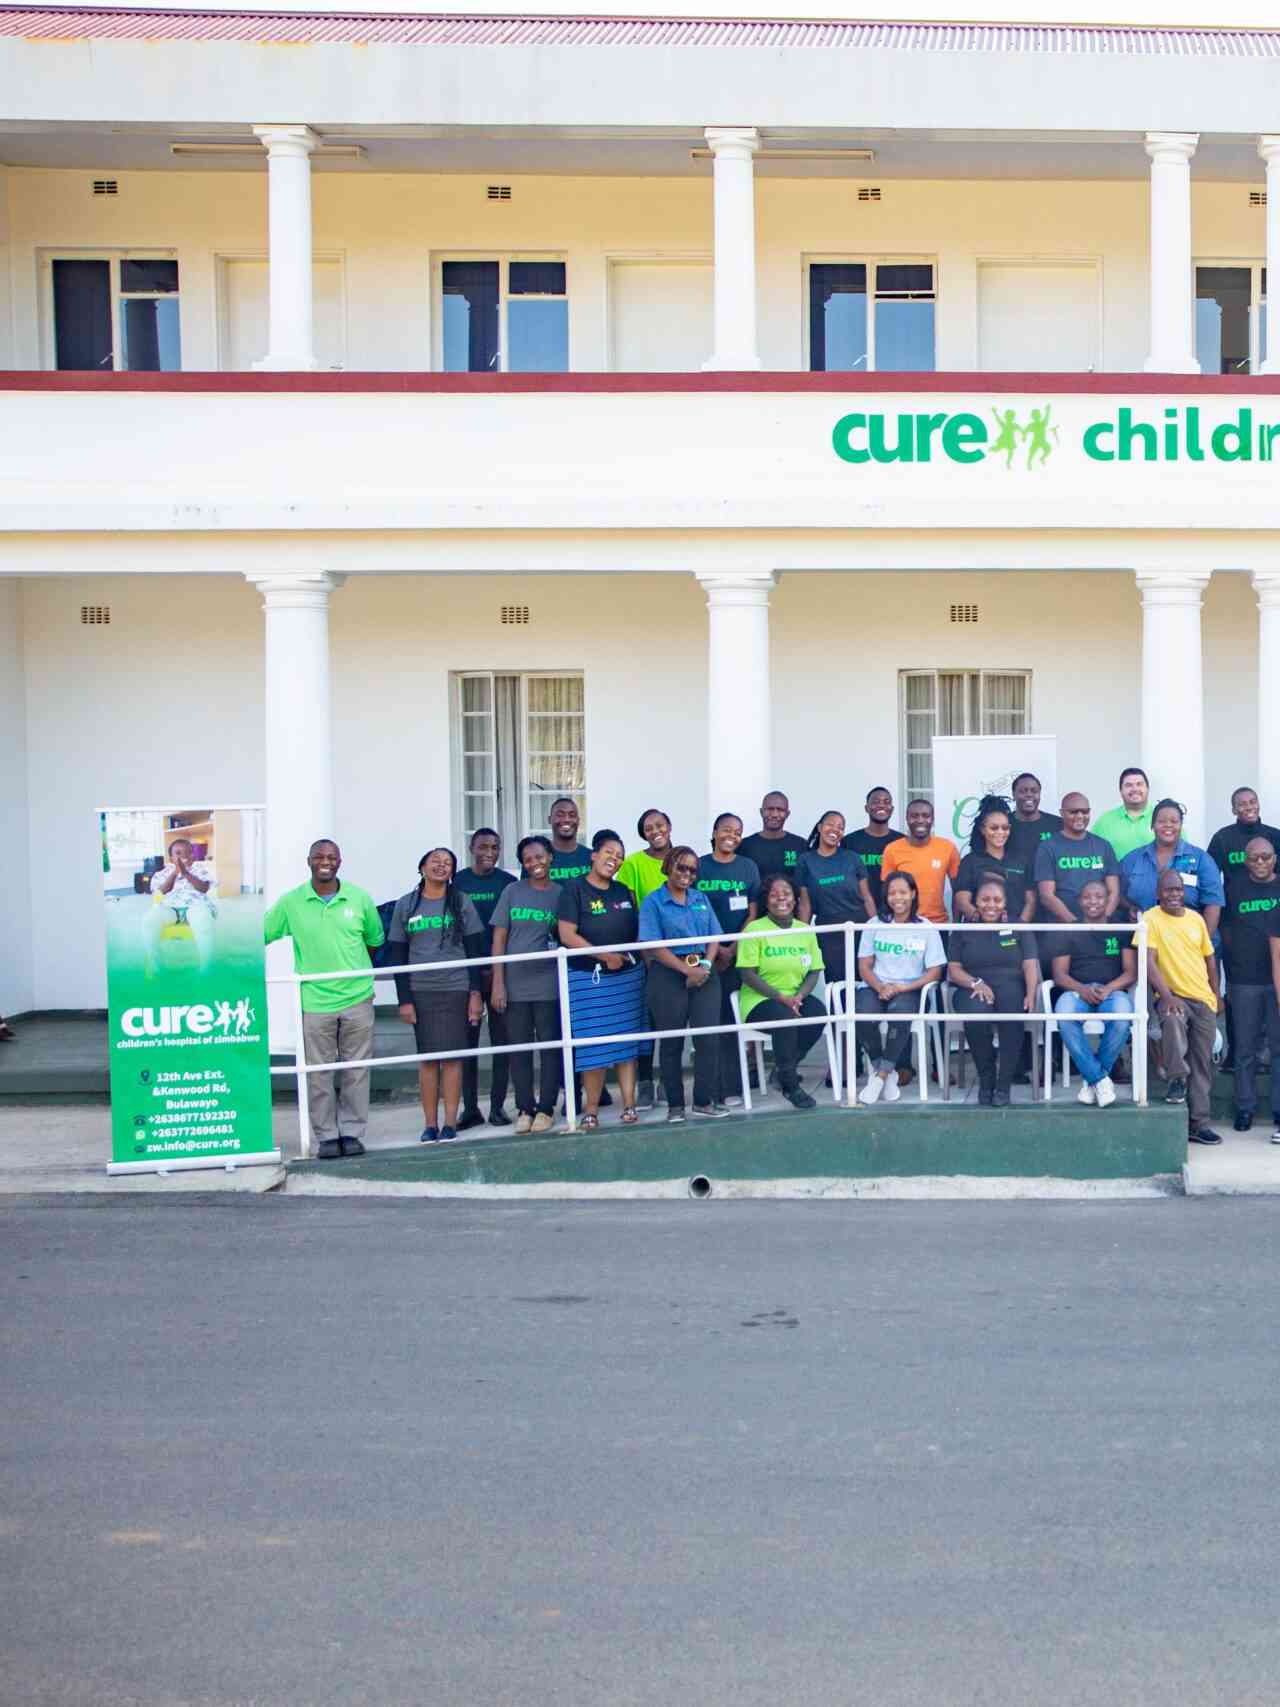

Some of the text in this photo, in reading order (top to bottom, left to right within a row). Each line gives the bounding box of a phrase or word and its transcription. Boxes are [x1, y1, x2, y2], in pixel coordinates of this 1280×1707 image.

[832, 412, 988, 464] cure
[1058, 856, 1091, 869] cure
[1229, 851, 1246, 864] cu
[549, 867, 580, 880] cure
[697, 879, 732, 891] cure
[1239, 899, 1271, 912] cure
[510, 907, 545, 922] cure
[764, 945, 797, 957] cure
[121, 1004, 214, 1037] cure
[157, 1070, 224, 1082] 12th Ave Ext.
[152, 1084, 210, 1096] &Kenwood
[166, 1099, 218, 1109] Bulawayo
